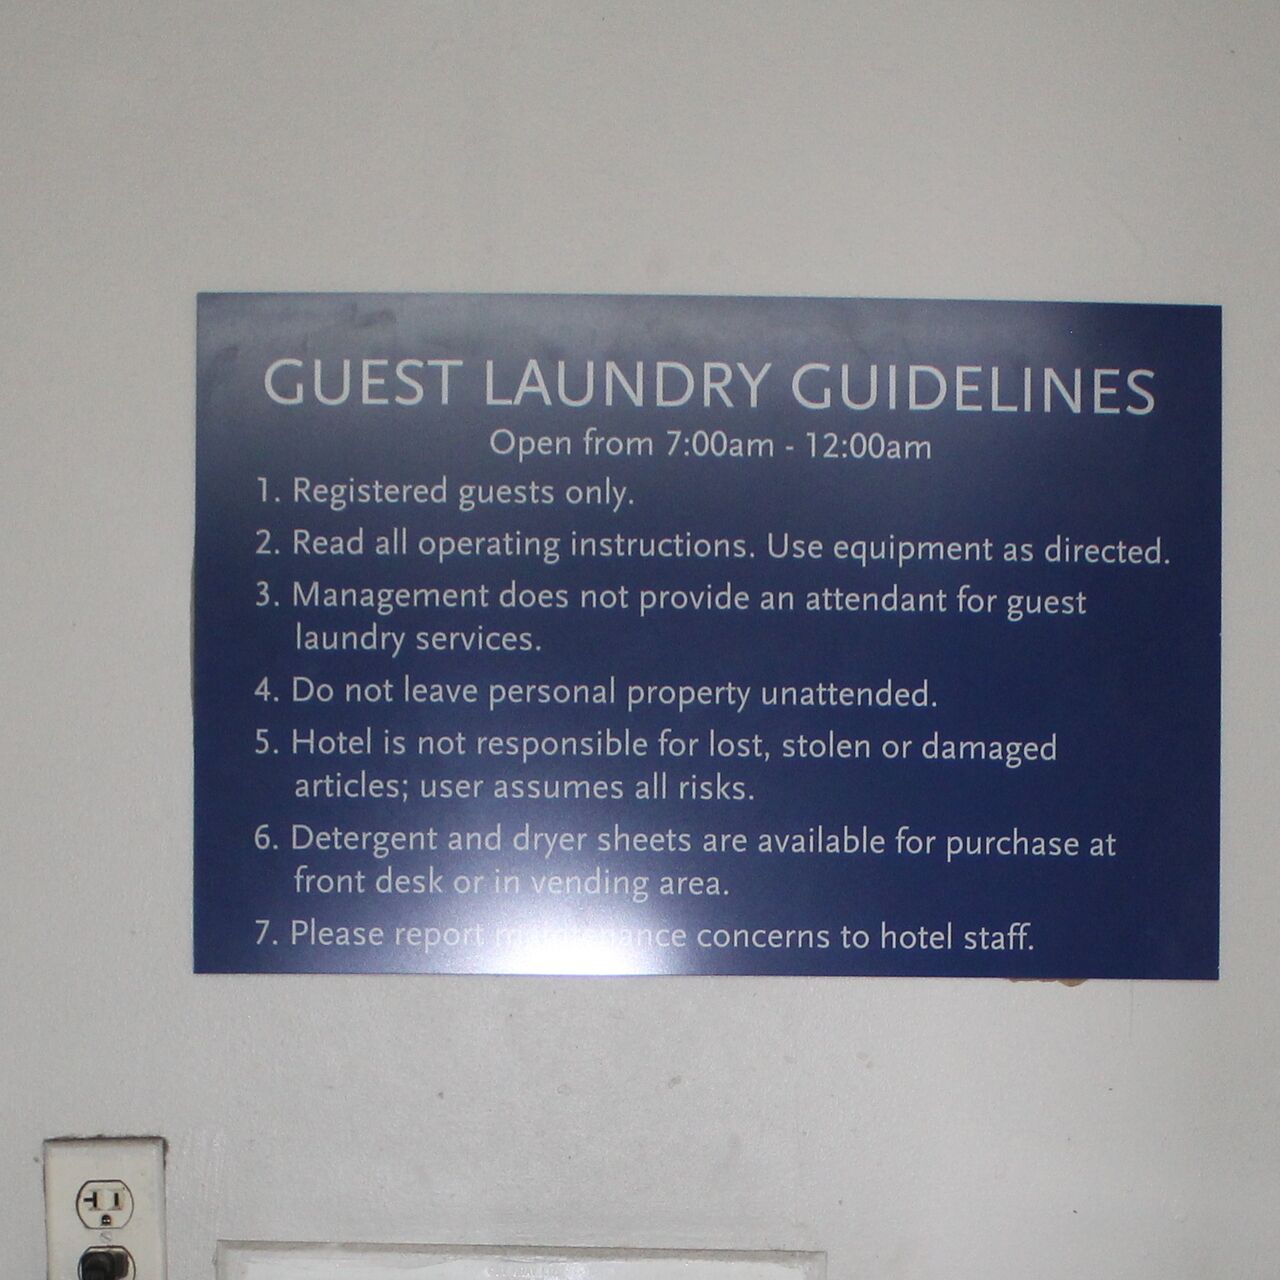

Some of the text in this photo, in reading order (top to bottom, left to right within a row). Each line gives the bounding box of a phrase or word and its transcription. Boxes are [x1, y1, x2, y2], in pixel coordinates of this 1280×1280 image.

[264, 357, 1156, 416] GUEST LAUNDRY GUIDELINES
[489, 427, 572, 464] Open
[582, 426, 654, 457] from
[666, 429, 774, 458] 7:00am
[805, 431, 932, 460] 12:00am
[256, 474, 635, 514] 1. Registered guests only.
[255, 526, 1171, 569] 2. Read all operating instructions. Use equipment as directed.
[255, 579, 1088, 623] 3. Management does not provide an attendant for guest
[296, 620, 542, 659] laundry services.
[253, 673, 938, 714] 4. Do not leave personal property unattended.
[254, 725, 1057, 770] 5. Hotel is not responsible for lost, stolen or damaged
[294, 769, 755, 804] articles; user assumes all risks.
[253, 822, 1117, 864] 6. Detergent and dryer sheets are available for purchase at
[293, 864, 730, 903] front desk or in vending area.
[254, 918, 279, 946] 7.
[291, 916, 385, 946] Please
[395, 922, 485, 954] report
[696, 927, 831, 950] concerns
[840, 925, 870, 950] to
[880, 920, 953, 951] hotel
[963, 921, 1035, 951] staff.
